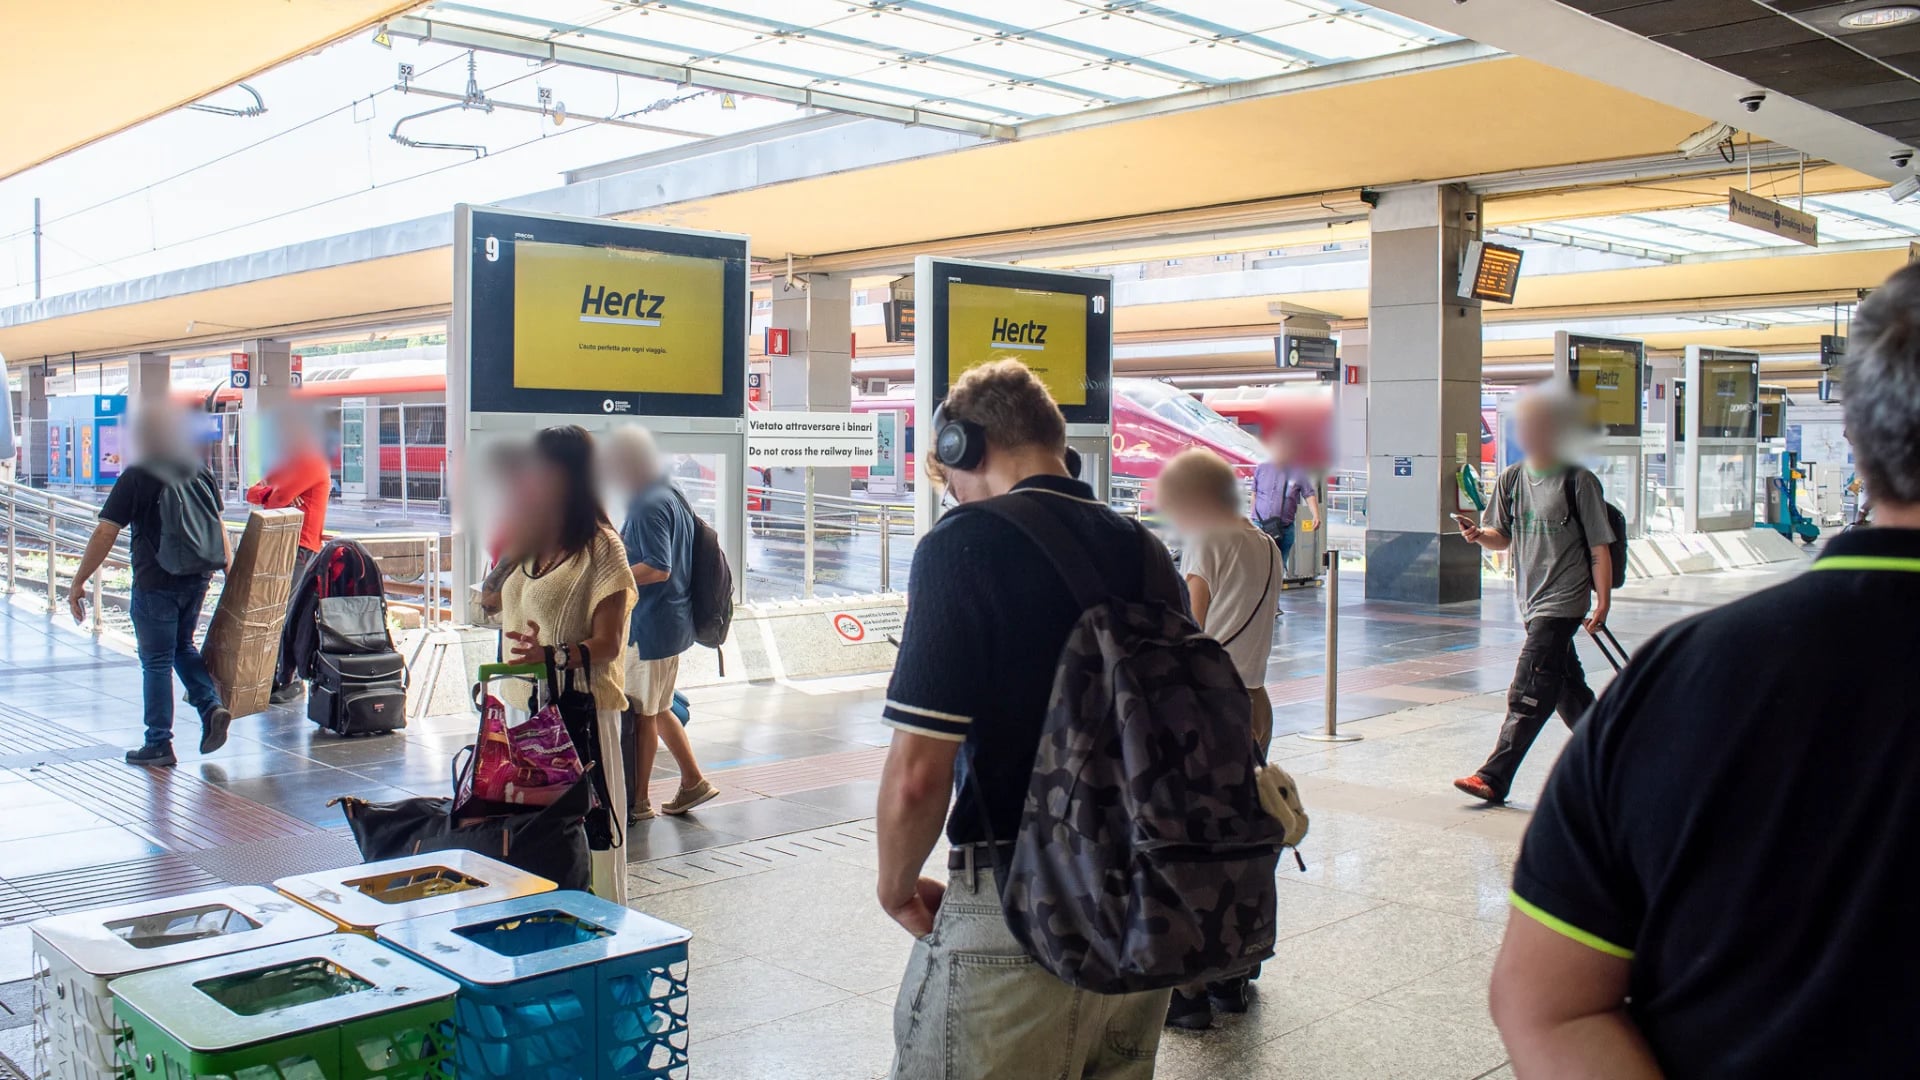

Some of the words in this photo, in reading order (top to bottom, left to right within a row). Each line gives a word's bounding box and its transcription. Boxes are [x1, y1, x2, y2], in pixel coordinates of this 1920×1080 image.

[401, 66, 412, 75] 52
[540, 90, 550, 98] 52
[486, 237, 499, 261] 9
[581, 285, 665, 318] Hertz
[1092, 295, 1105, 315] 10
[992, 317, 1047, 344] Hertz
[632, 346, 644, 354] ogni
[1596, 370, 1619, 385] Hertz
[750, 421, 783, 431] Vietato
[786, 422, 840, 431] attraversare
[847, 422, 872, 432] binari
[749, 446, 761, 455] Do
[764, 447, 778, 456] not
[804, 446, 818, 456] the
[820, 446, 851, 458] railway
[855, 447, 873, 456] lines
